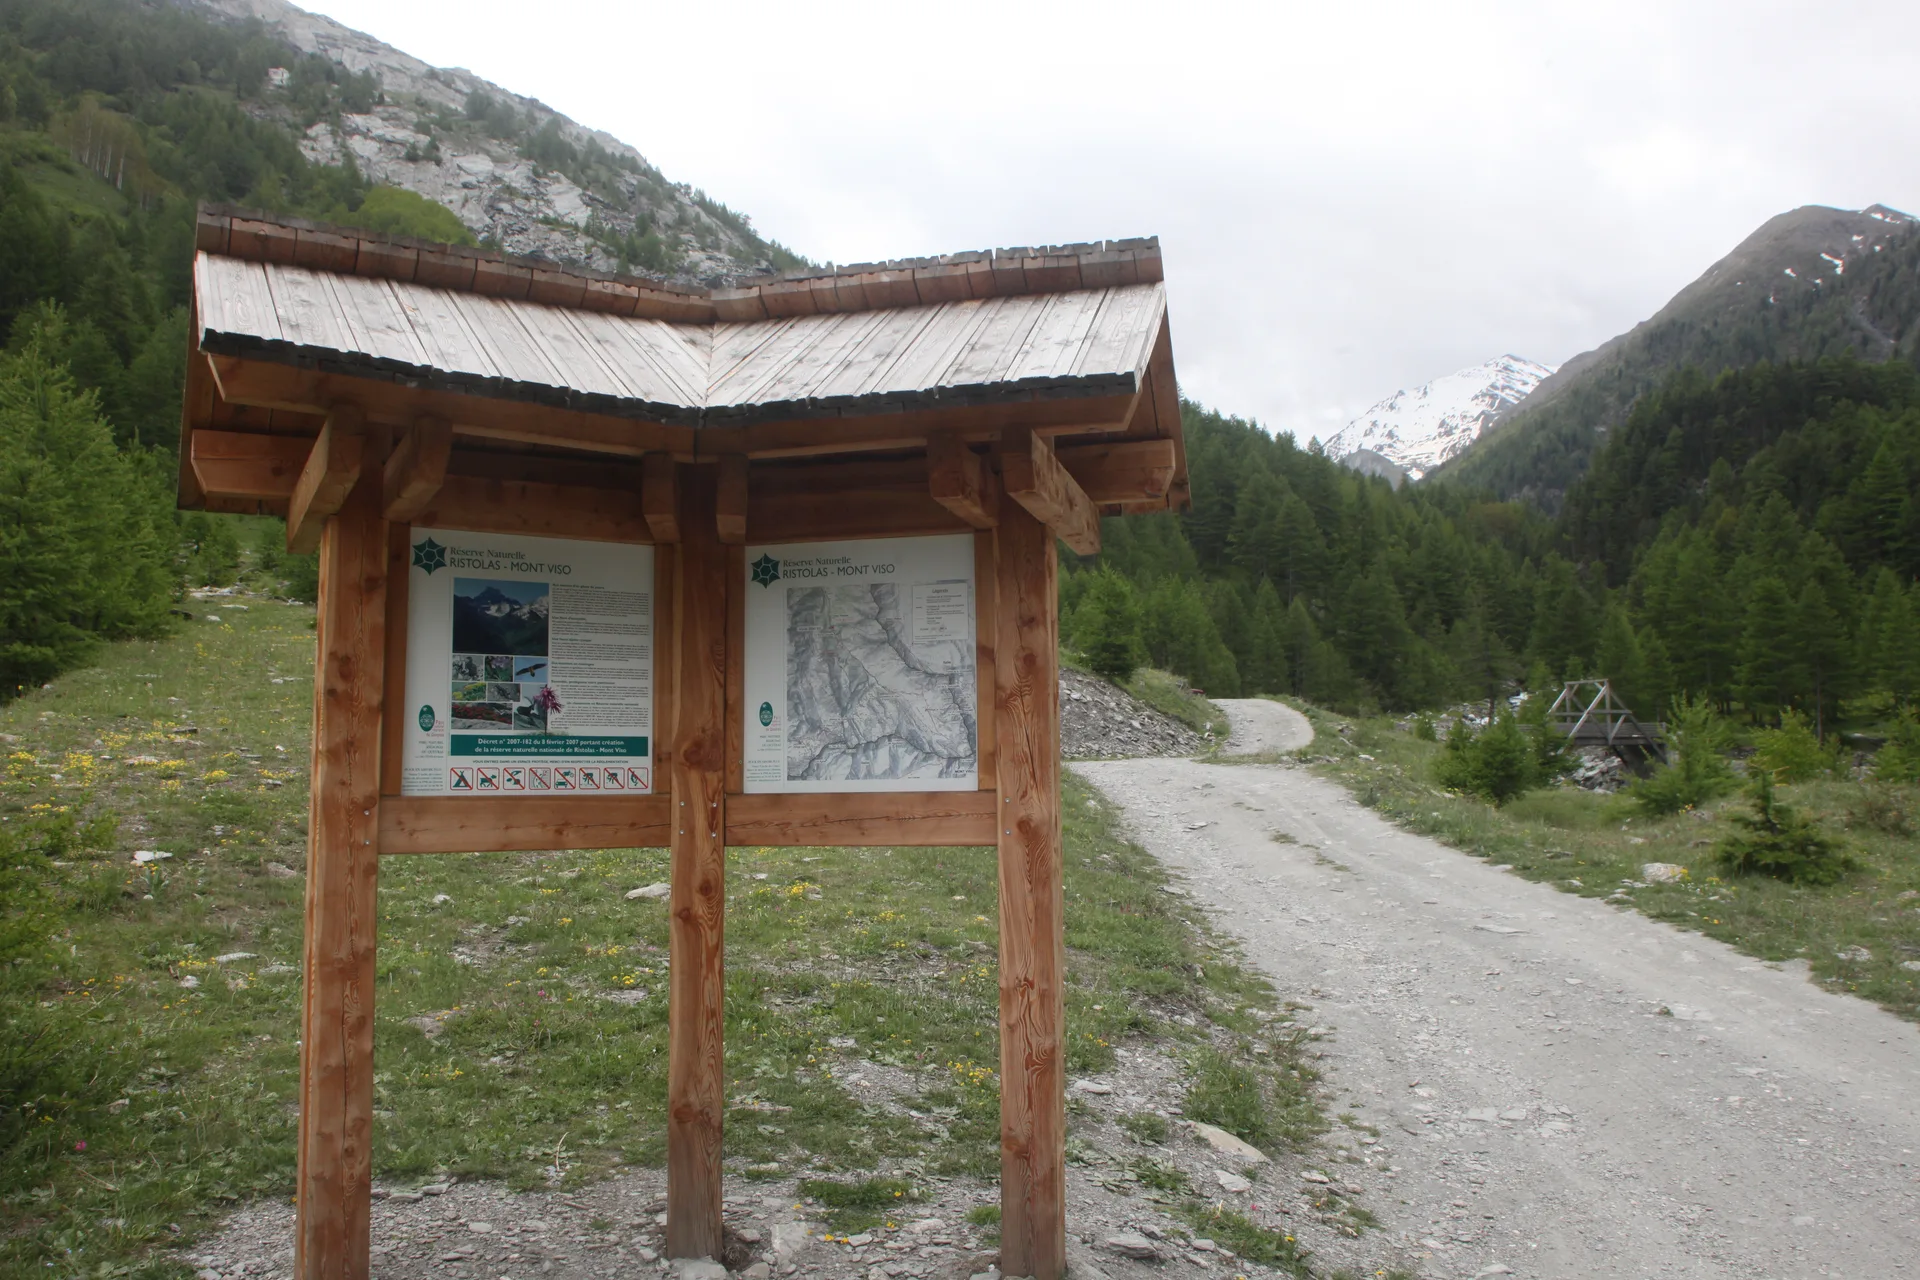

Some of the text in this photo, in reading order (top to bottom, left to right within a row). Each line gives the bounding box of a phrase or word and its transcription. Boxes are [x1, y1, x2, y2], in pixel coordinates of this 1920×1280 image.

[450, 546, 526, 560] Réserve Naturelle
[449, 558, 500, 570] RISTOLAS
[511, 562, 544, 573] MONT
[548, 564, 572, 575] VISO
[816, 556, 851, 566] Naturelle
[783, 567, 828, 579] RISTOLAS
[838, 565, 869, 576] MONT
[872, 564, 895, 574] VISO
